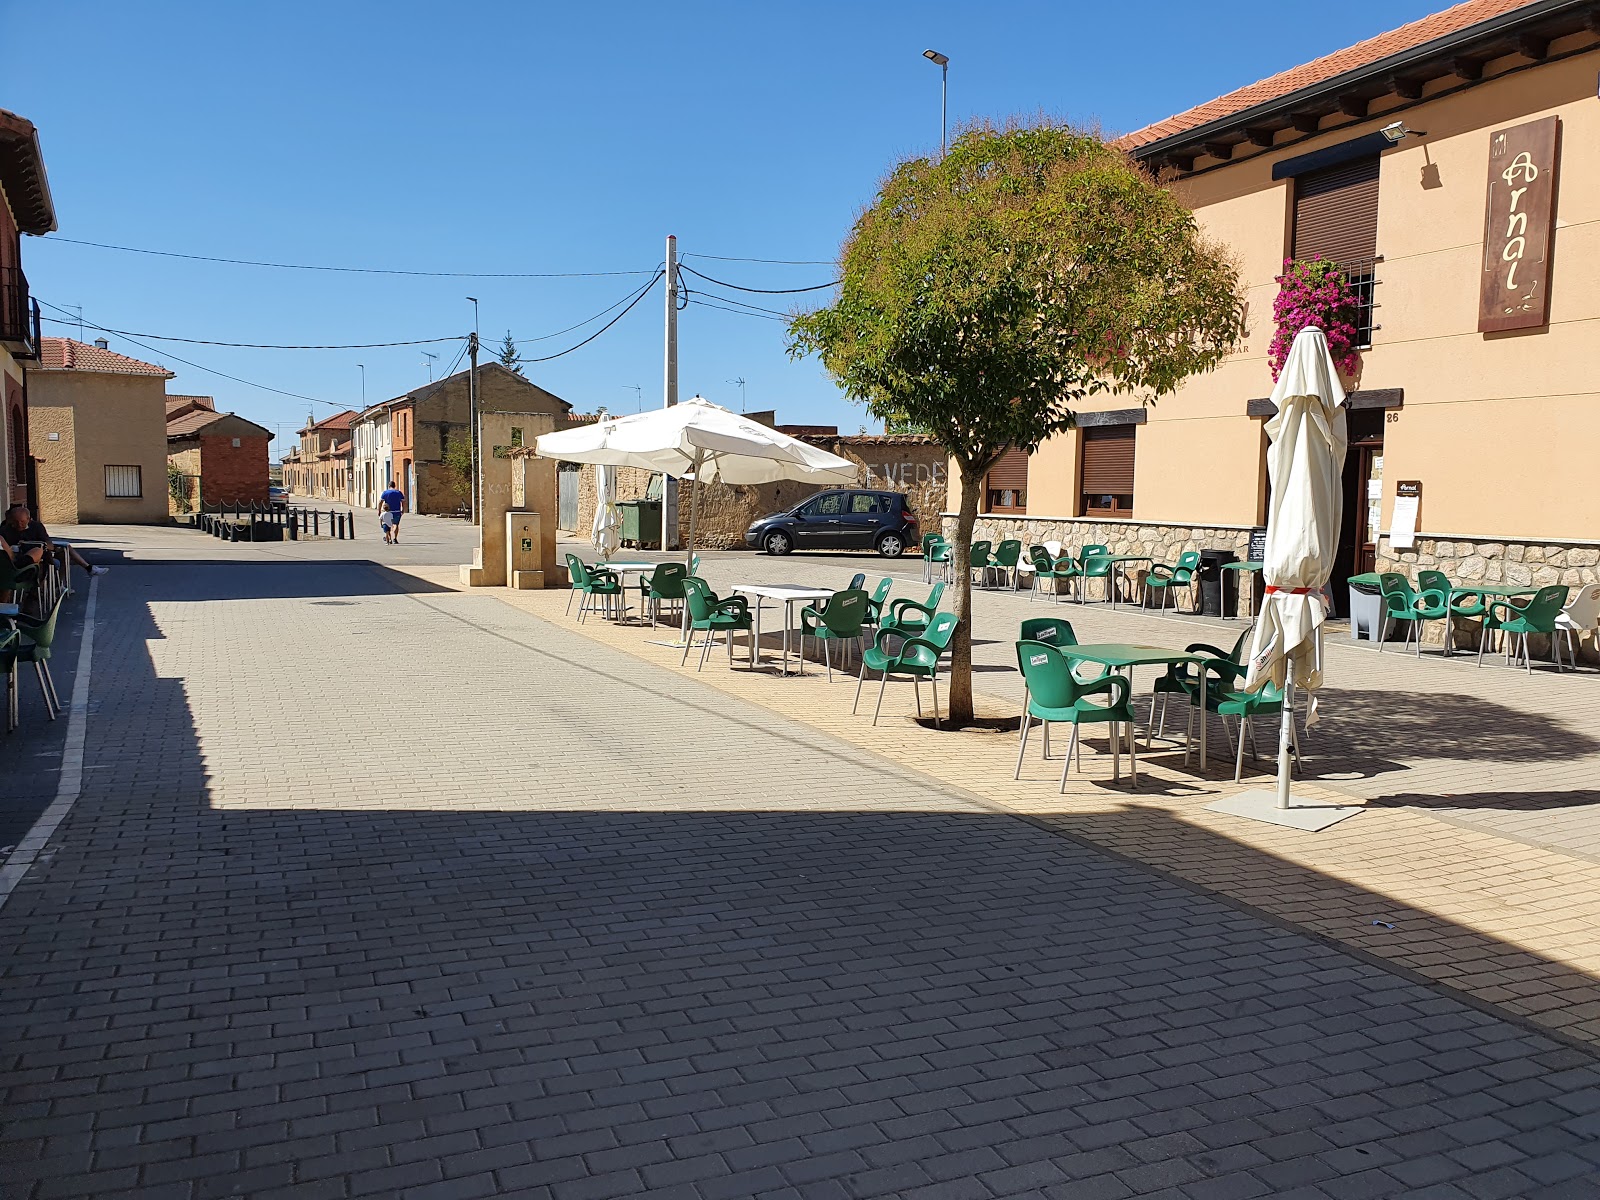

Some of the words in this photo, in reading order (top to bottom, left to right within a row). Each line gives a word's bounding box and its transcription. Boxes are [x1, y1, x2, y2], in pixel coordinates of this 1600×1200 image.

[1502, 151, 1539, 290] Arnal
[1230, 346, 1249, 355] BAR
[1386, 413, 1399, 423] 26
